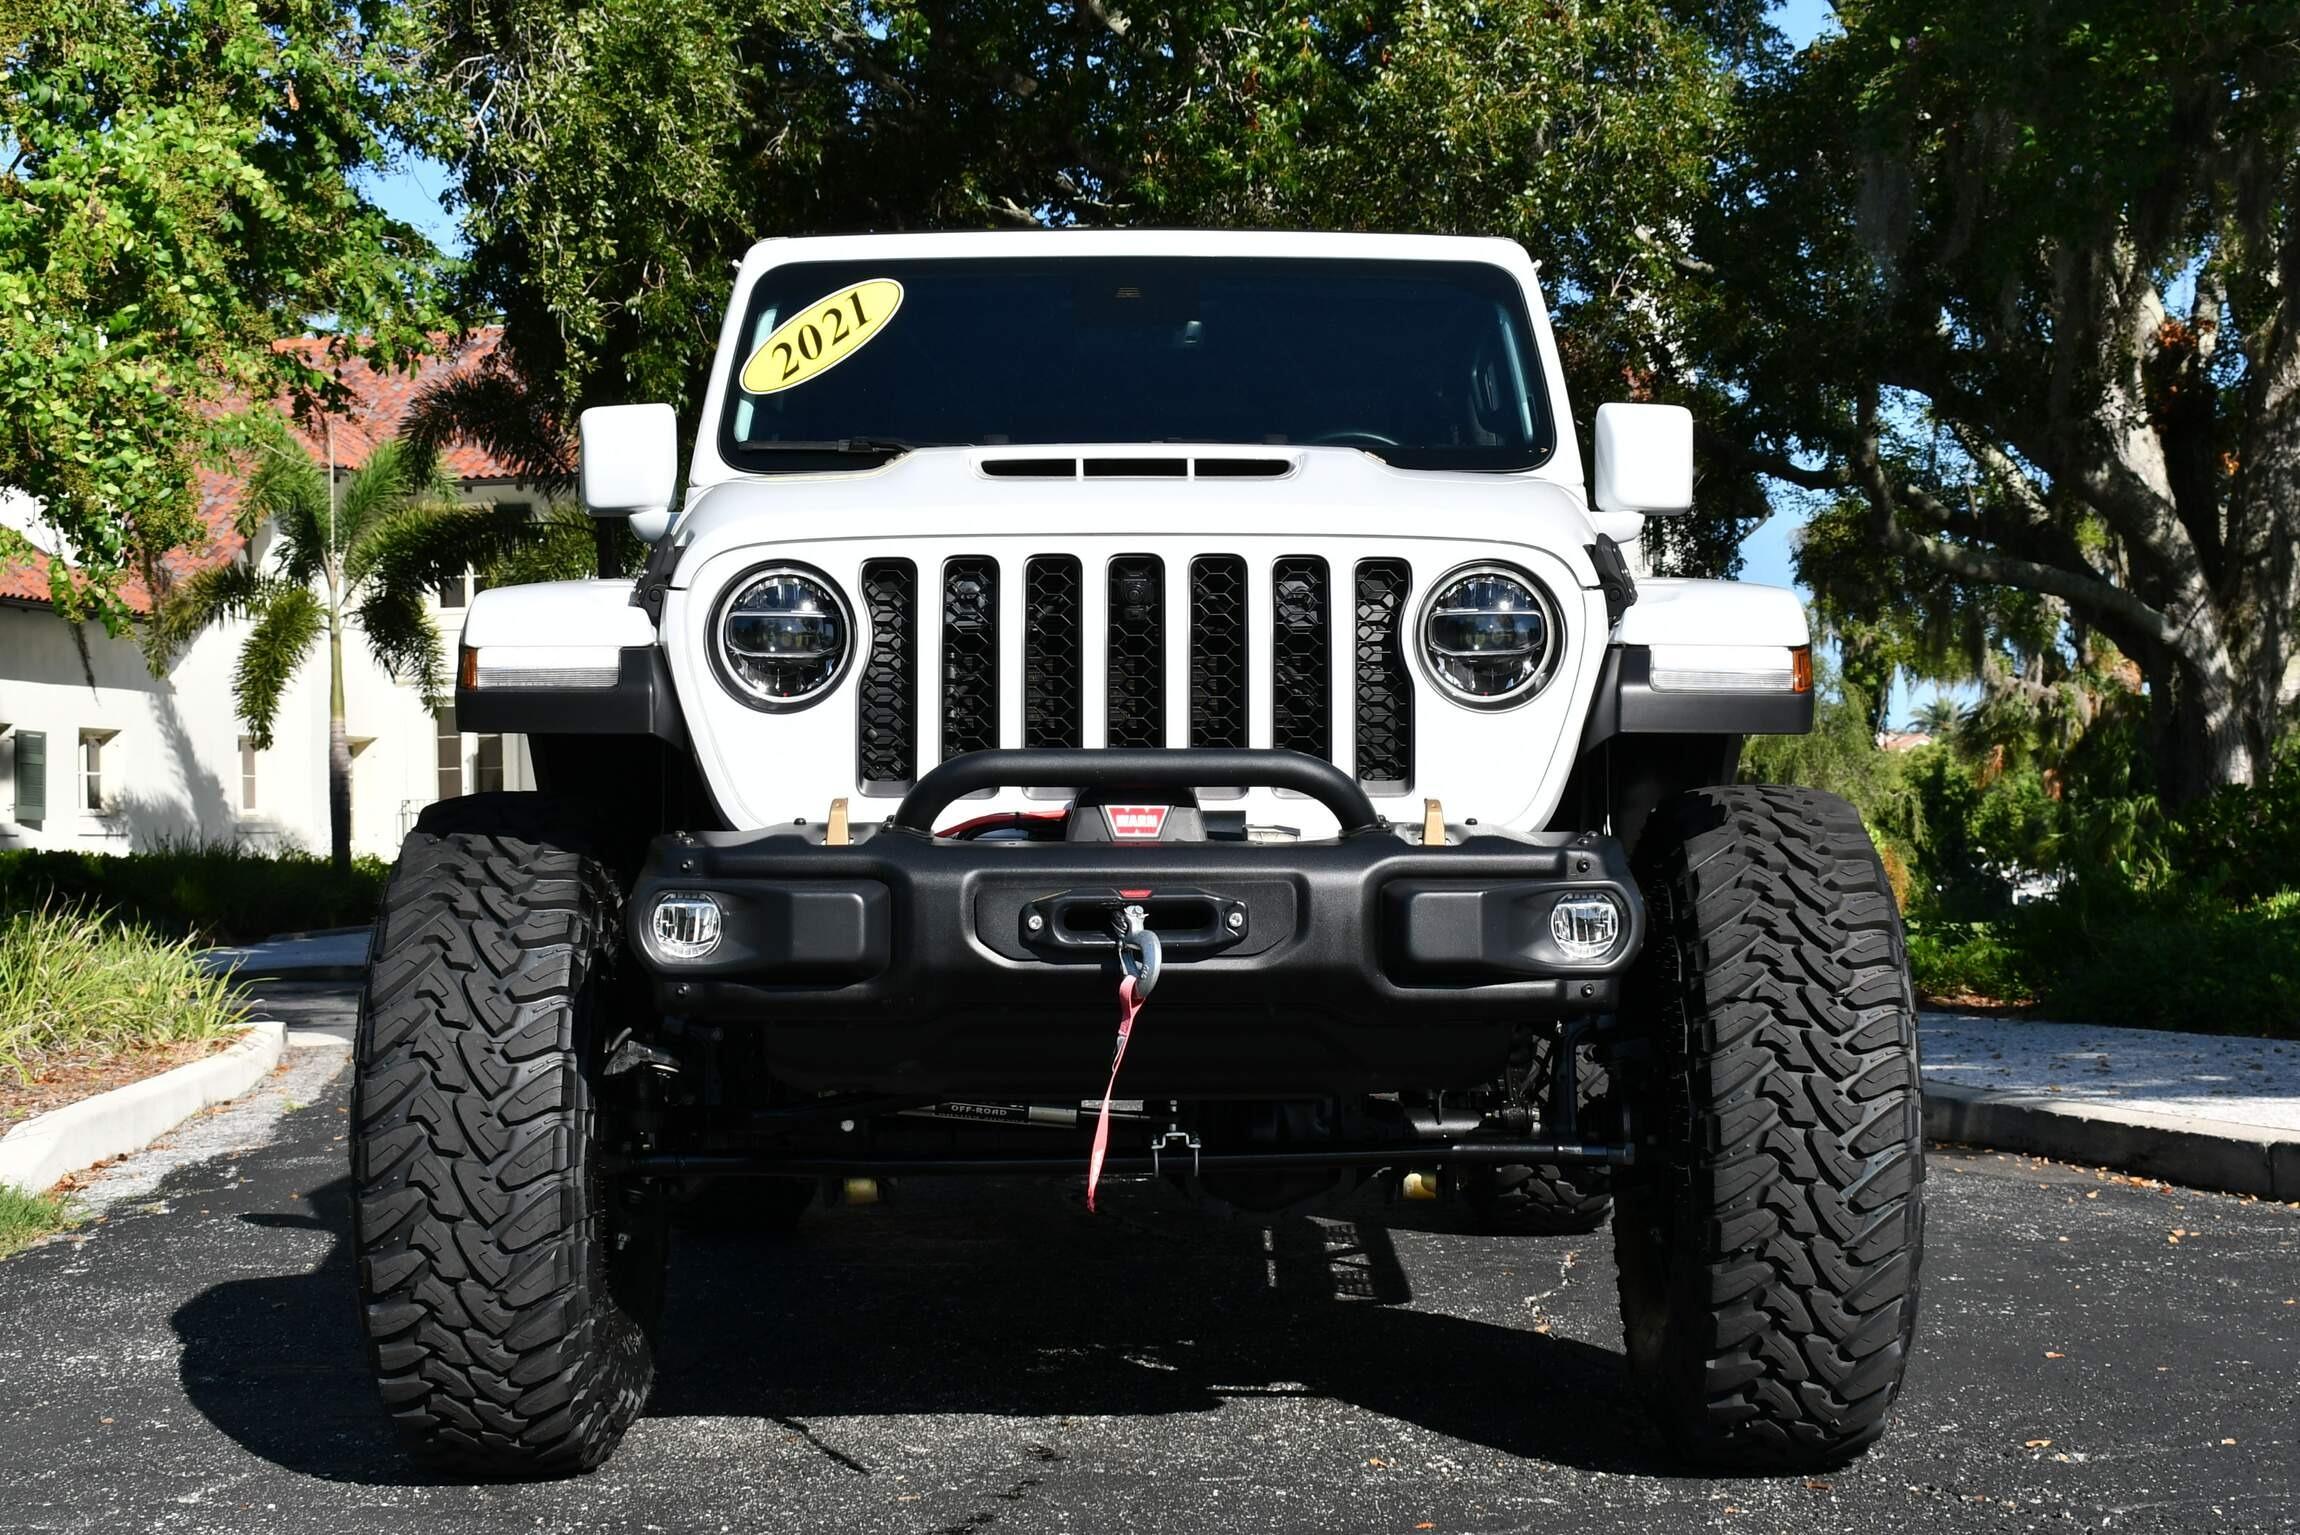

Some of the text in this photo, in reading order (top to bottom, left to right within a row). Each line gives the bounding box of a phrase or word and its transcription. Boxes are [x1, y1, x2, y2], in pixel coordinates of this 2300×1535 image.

[772, 292, 872, 381] 2021
[1116, 815, 1157, 828] WARN
[951, 1104, 1008, 1116] OFF-ROAD
